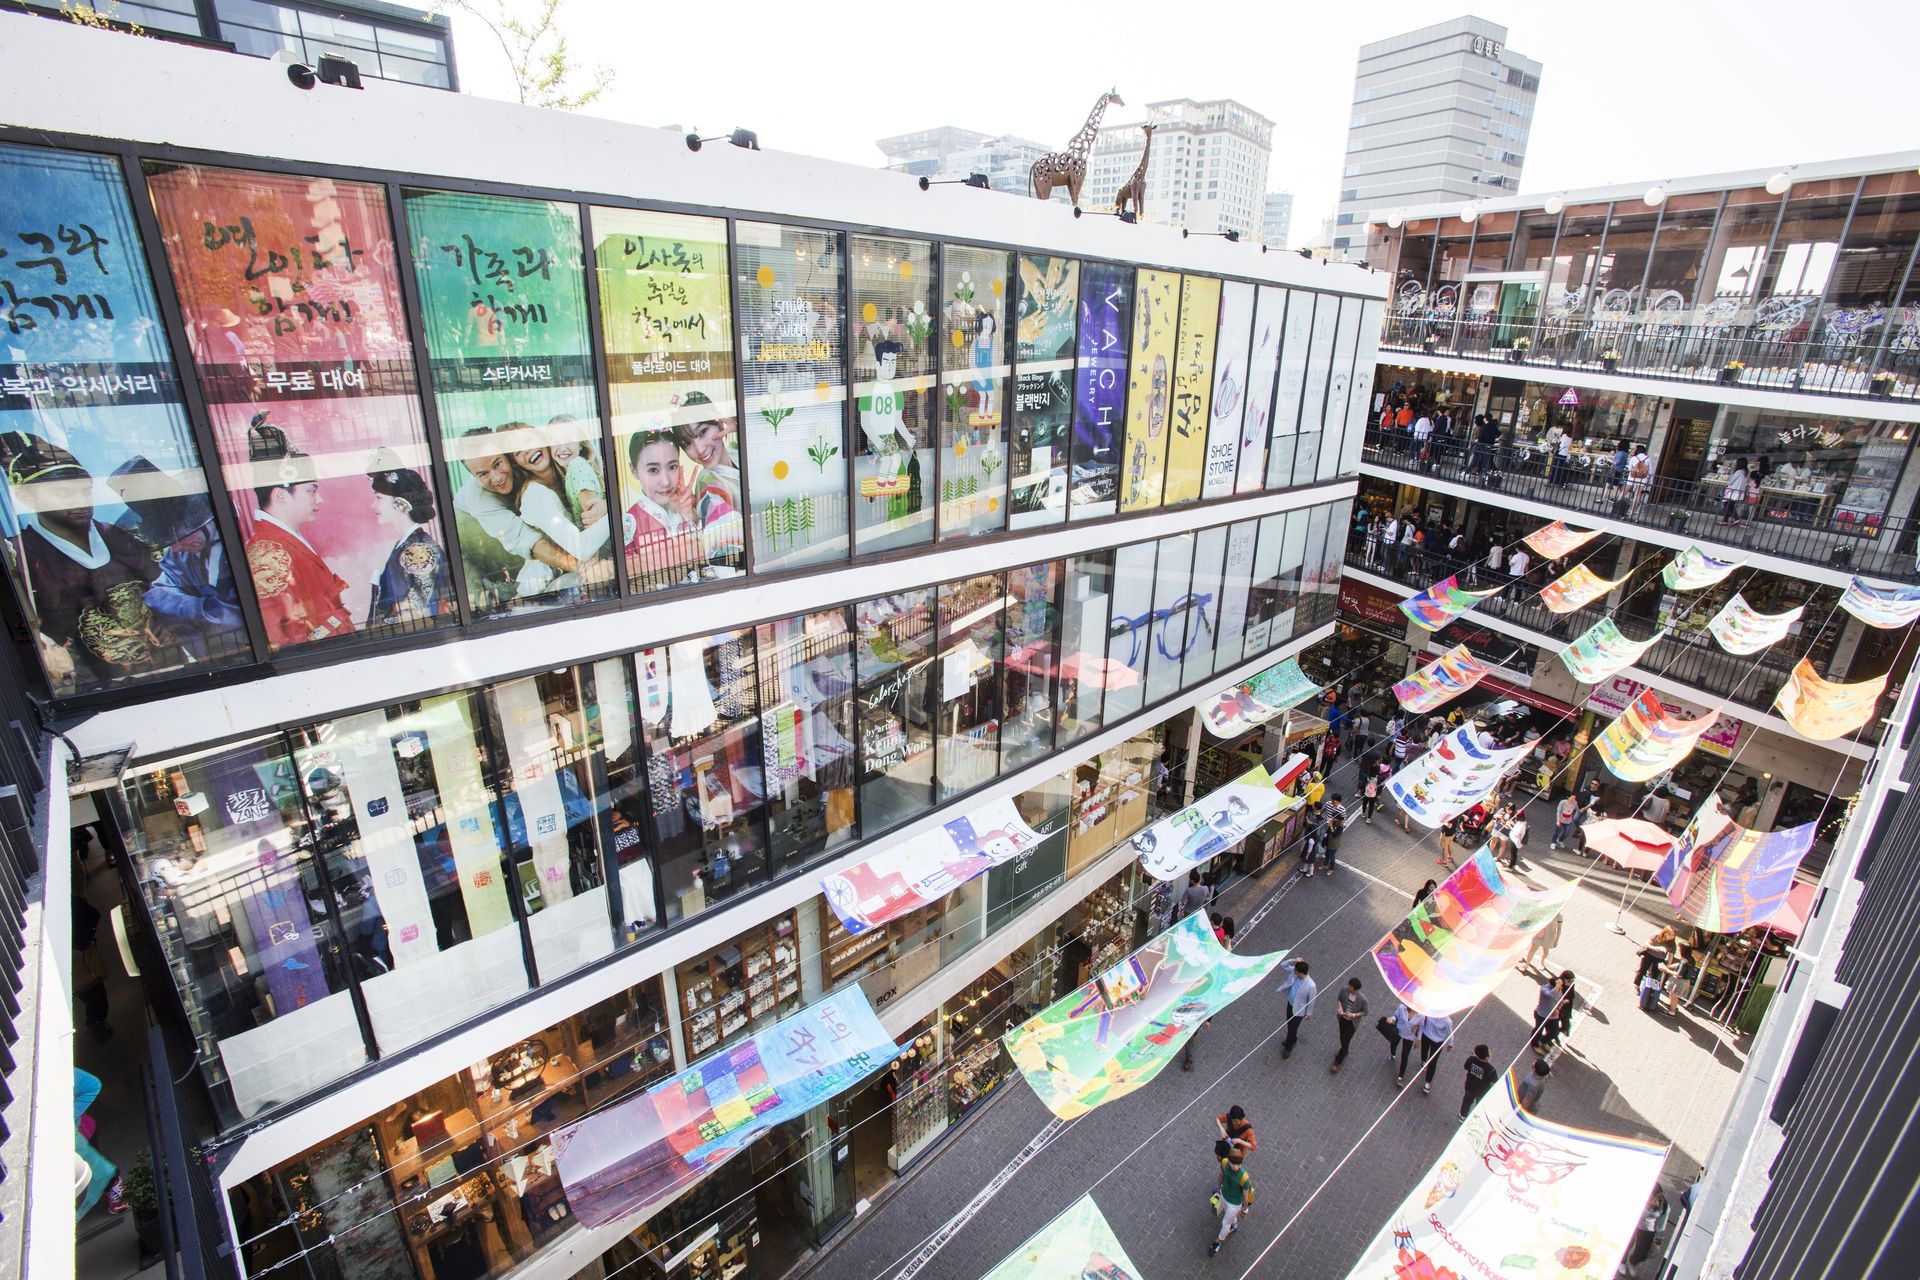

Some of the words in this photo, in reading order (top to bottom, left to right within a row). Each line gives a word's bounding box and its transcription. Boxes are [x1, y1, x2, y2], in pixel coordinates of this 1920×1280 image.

[0, 223, 109, 285] 구와
[441, 234, 553, 292] 가족과
[624, 236, 704, 273] 인사동의
[249, 286, 354, 337] 함께
[469, 292, 548, 336] 함께
[482, 365, 552, 382] 스티커사진
[632, 360, 687, 374] 폴라로이드
[690, 359, 712, 373] 대여
[1088, 339, 1098, 404] JEWELRY
[1093, 286, 1121, 456] VACHI
[62, 373, 158, 397] 악세서리
[266, 370, 316, 394] 무료
[321, 368, 365, 391] 대여
[876, 396, 893, 415] 08
[1015, 392, 1050, 412] 블랙반지
[1211, 443, 1233, 459] SHOE
[1209, 459, 1234, 476] STORE
[864, 752, 898, 774] Dong
[901, 741, 928, 758] Won
[1015, 861, 1028, 875] Gift
[876, 986, 897, 1007] BOX
